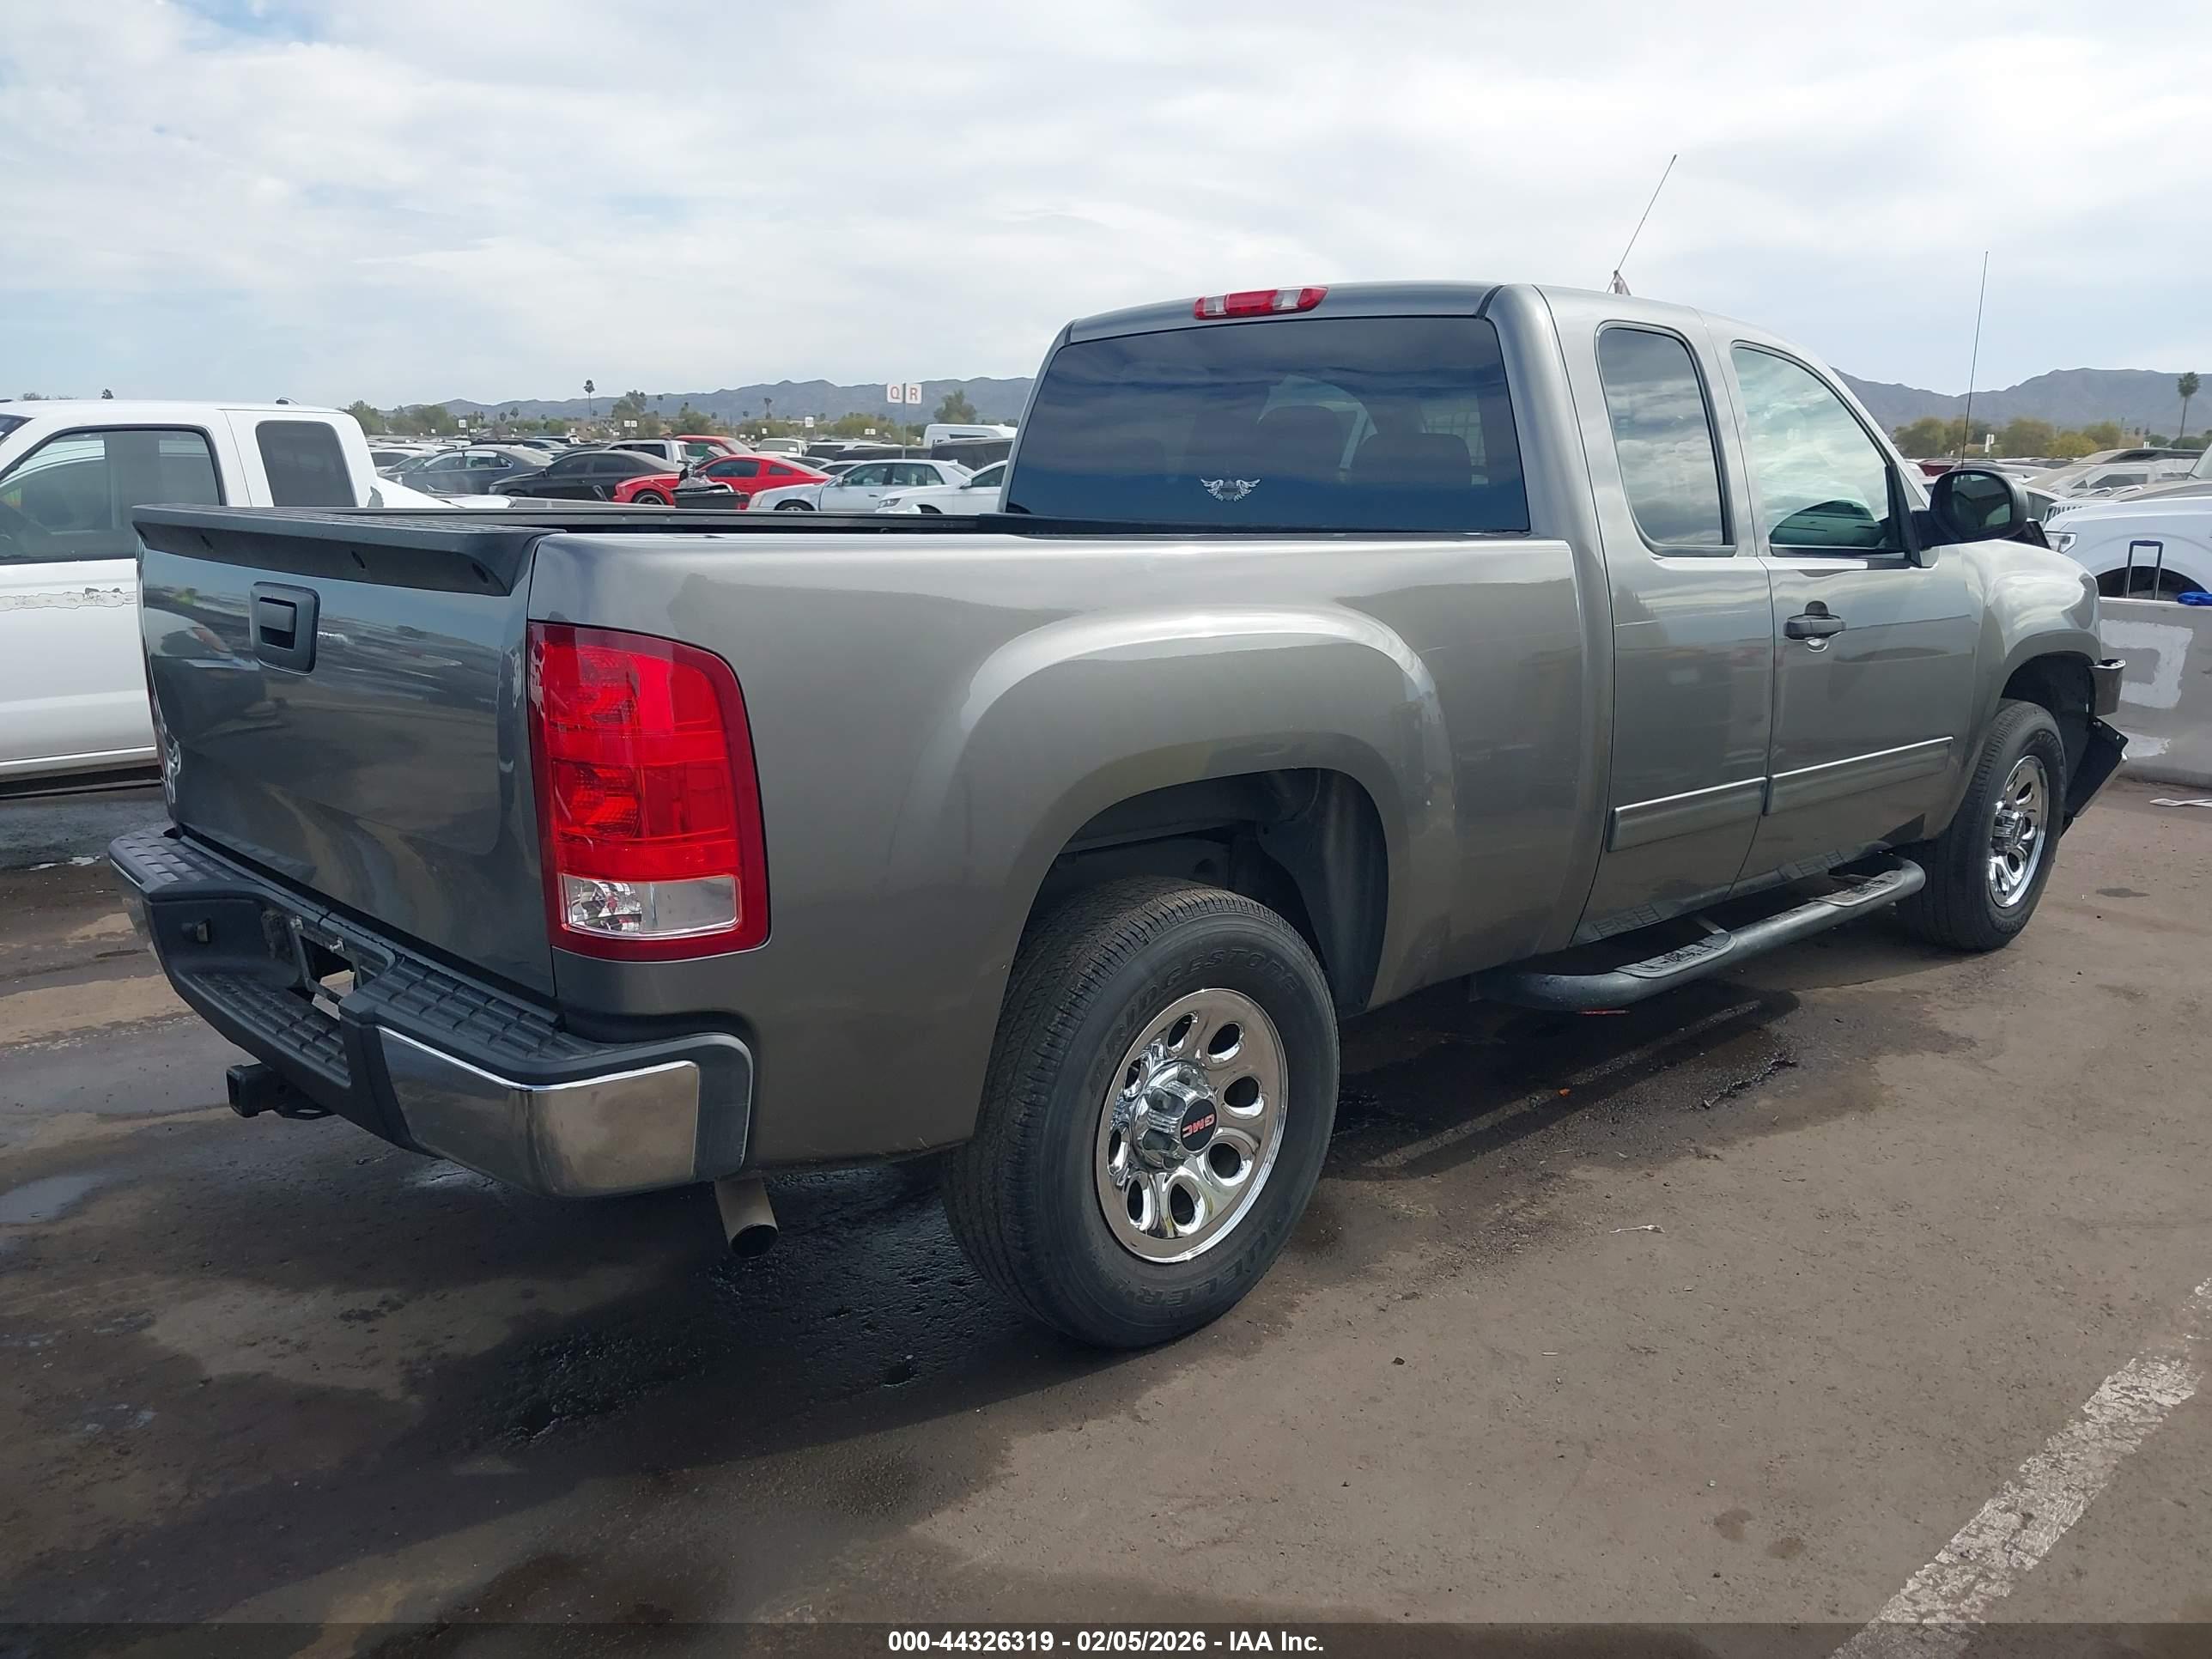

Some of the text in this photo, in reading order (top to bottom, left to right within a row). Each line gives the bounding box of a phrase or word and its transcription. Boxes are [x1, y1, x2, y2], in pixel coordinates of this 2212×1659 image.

[890, 386, 900, 399] Q
[910, 387, 918, 400] R
[1182, 1114, 1215, 1139] GMC
